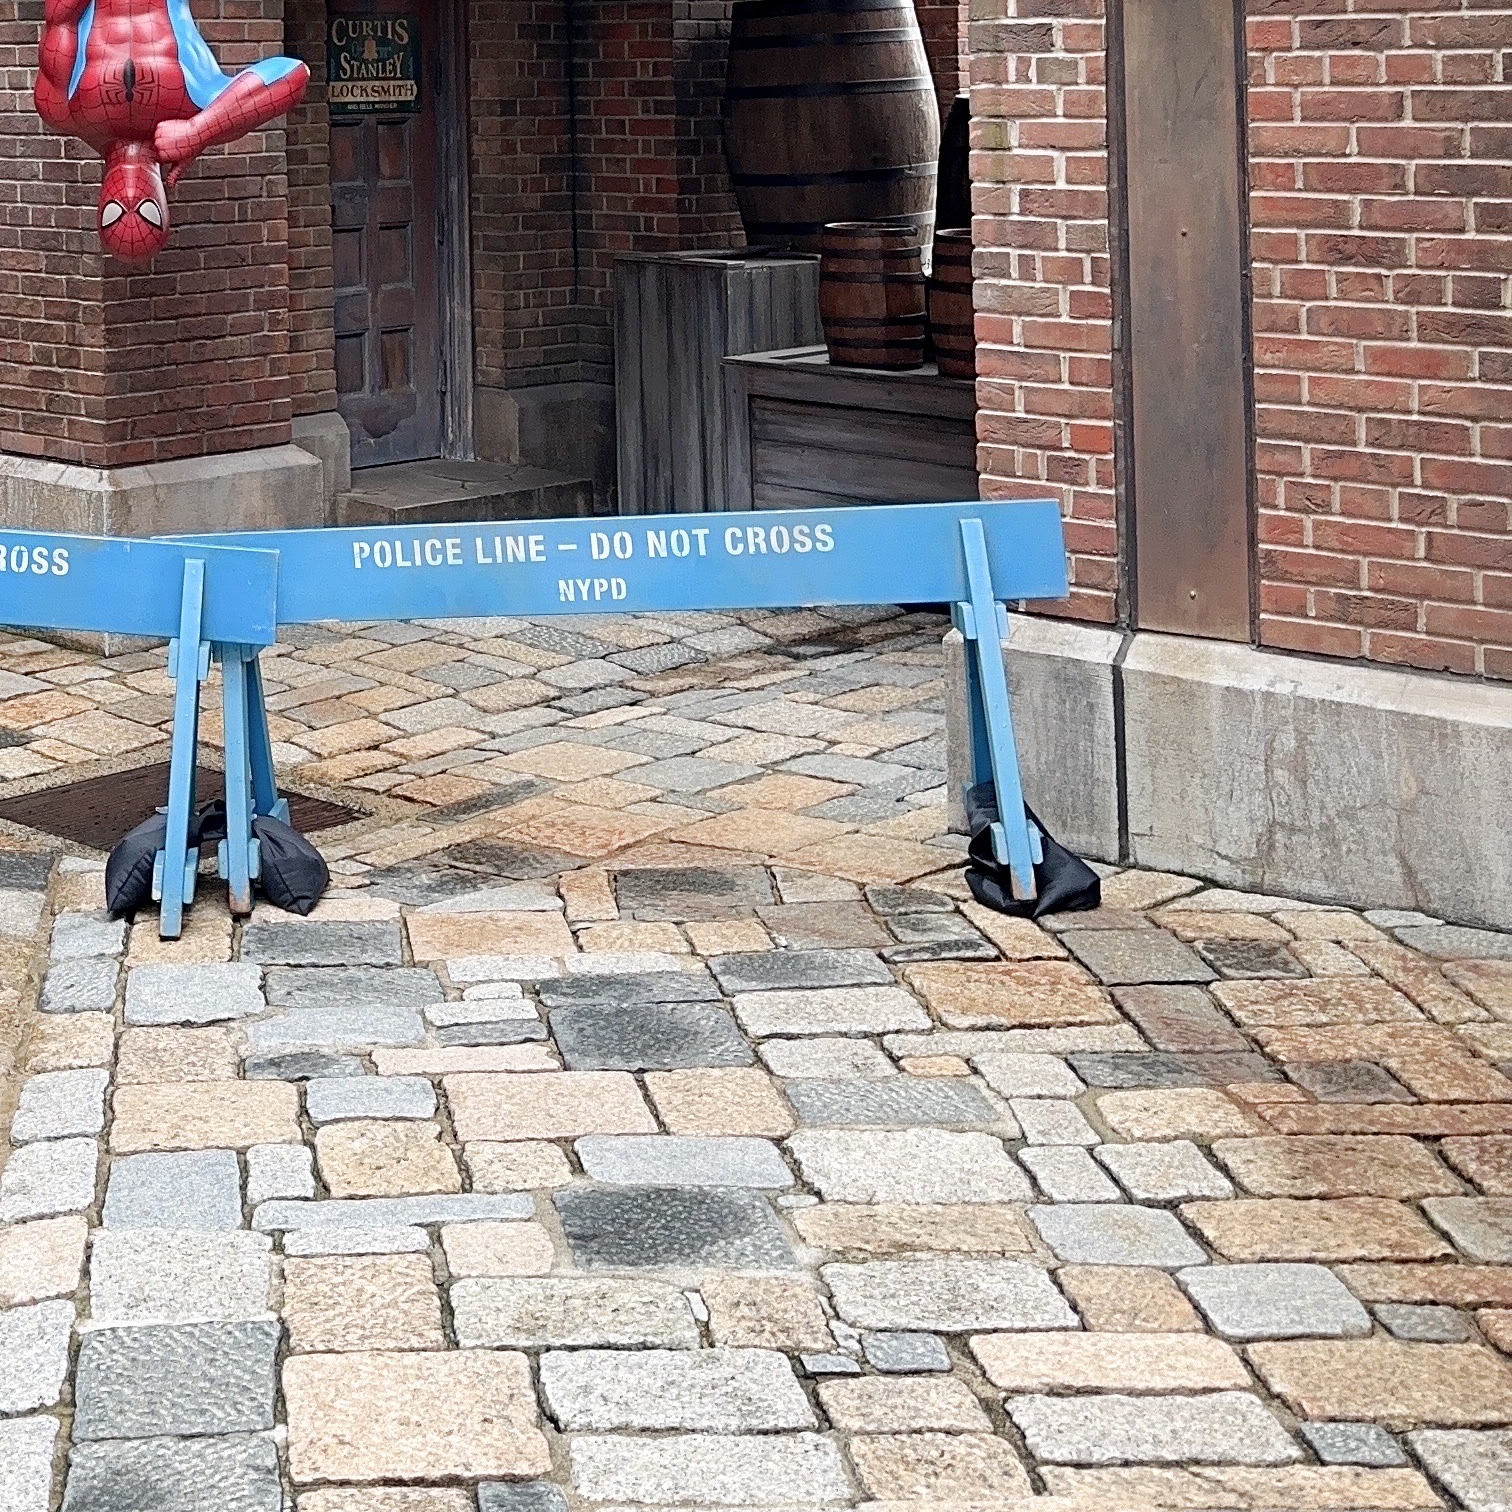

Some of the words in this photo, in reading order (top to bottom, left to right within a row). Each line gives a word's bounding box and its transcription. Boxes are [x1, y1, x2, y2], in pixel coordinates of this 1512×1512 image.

[331, 18, 409, 46] CURTIS
[339, 52, 405, 79] STANLEY
[331, 84, 414, 98] LOCKSMITH
[352, 537, 463, 569] POLICE
[475, 534, 547, 564] LINE
[590, 531, 634, 561] DO
[646, 528, 711, 558] NOT
[724, 523, 836, 556] CROSS
[558, 577, 627, 603] NYPD
